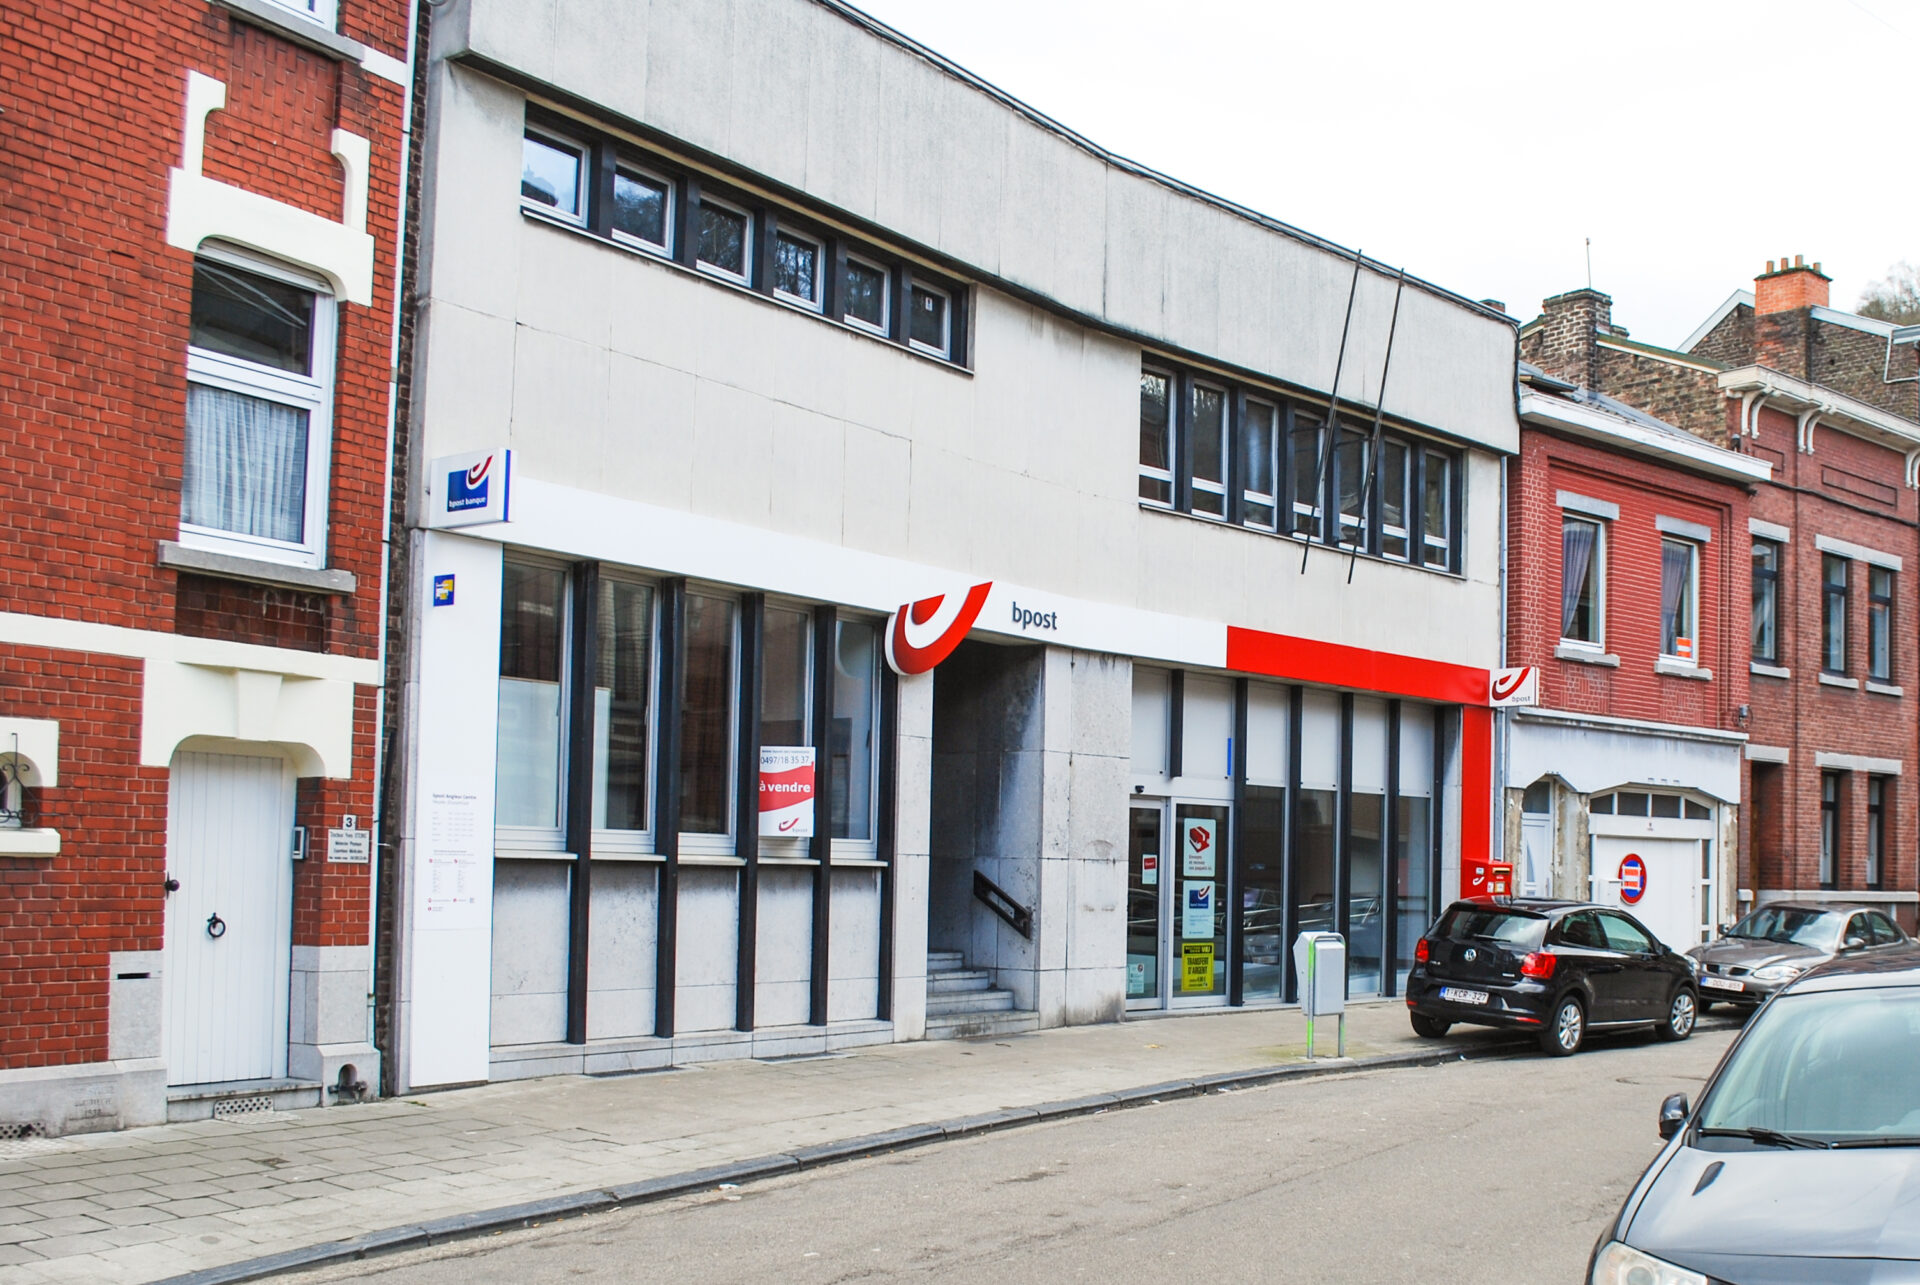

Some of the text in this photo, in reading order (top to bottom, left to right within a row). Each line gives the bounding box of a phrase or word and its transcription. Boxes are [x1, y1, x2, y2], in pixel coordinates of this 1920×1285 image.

[448, 497, 486, 508] bpost banque
[1012, 601, 1058, 630] bpost
[1511, 695, 1531, 703] bpost
[767, 782, 811, 793] vendre
[345, 817, 353, 828] 3
[1445, 988, 1487, 1001] 1-KCR-327
